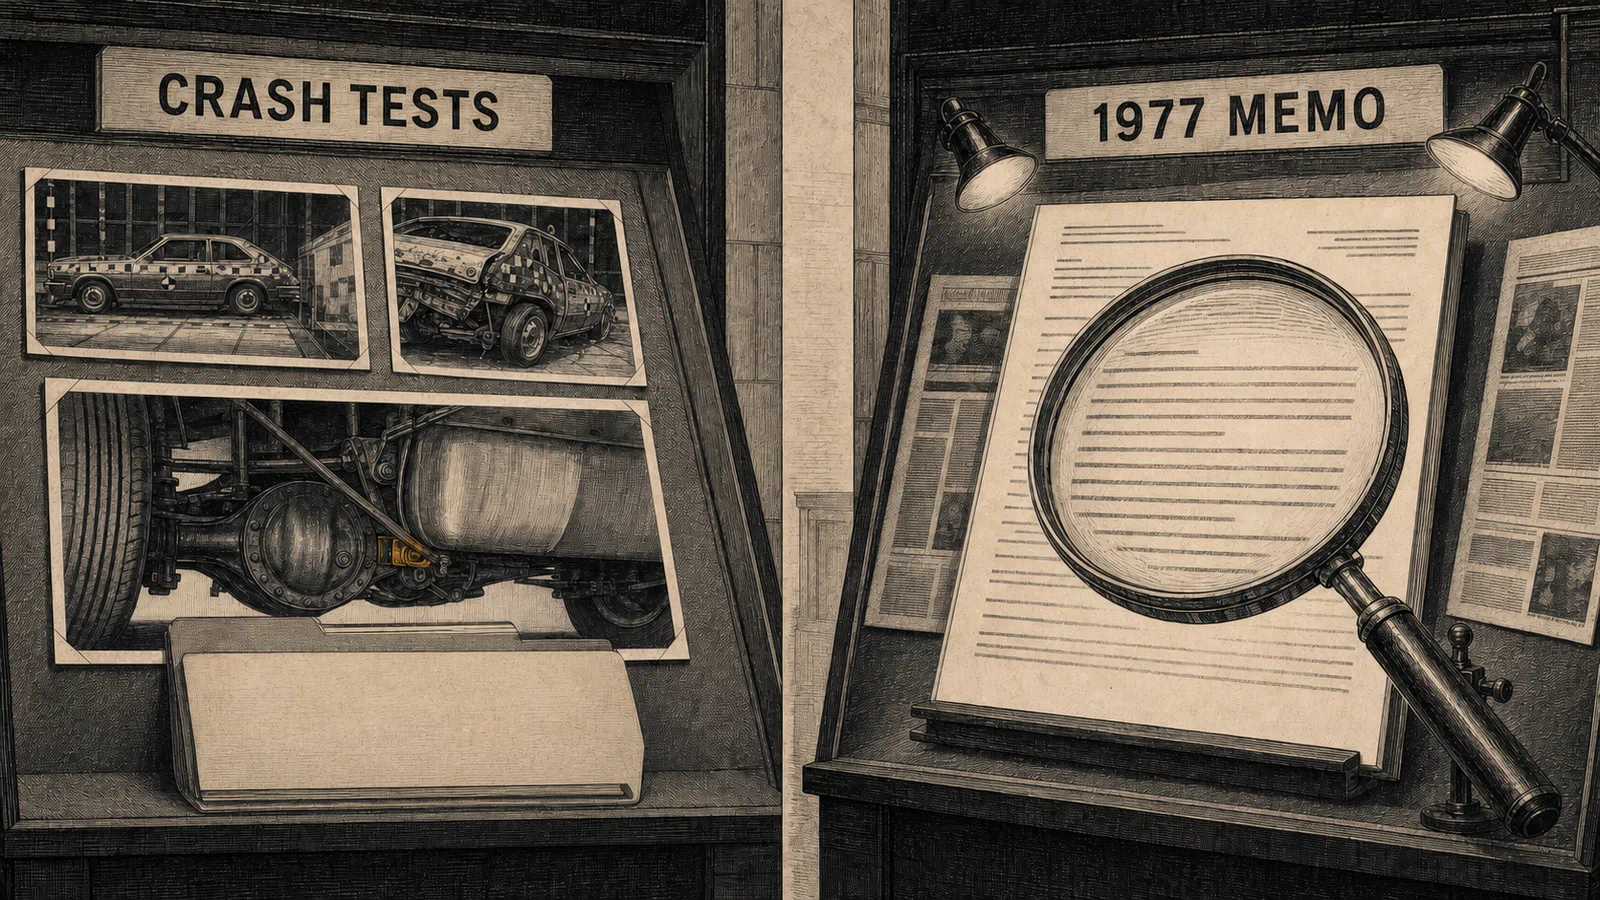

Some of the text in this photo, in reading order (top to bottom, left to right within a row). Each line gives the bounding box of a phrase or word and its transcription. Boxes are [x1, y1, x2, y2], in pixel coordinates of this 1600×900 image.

[158, 72, 499, 132] CRASH TESTS
[1093, 86, 1385, 142] 1977 MEMO
